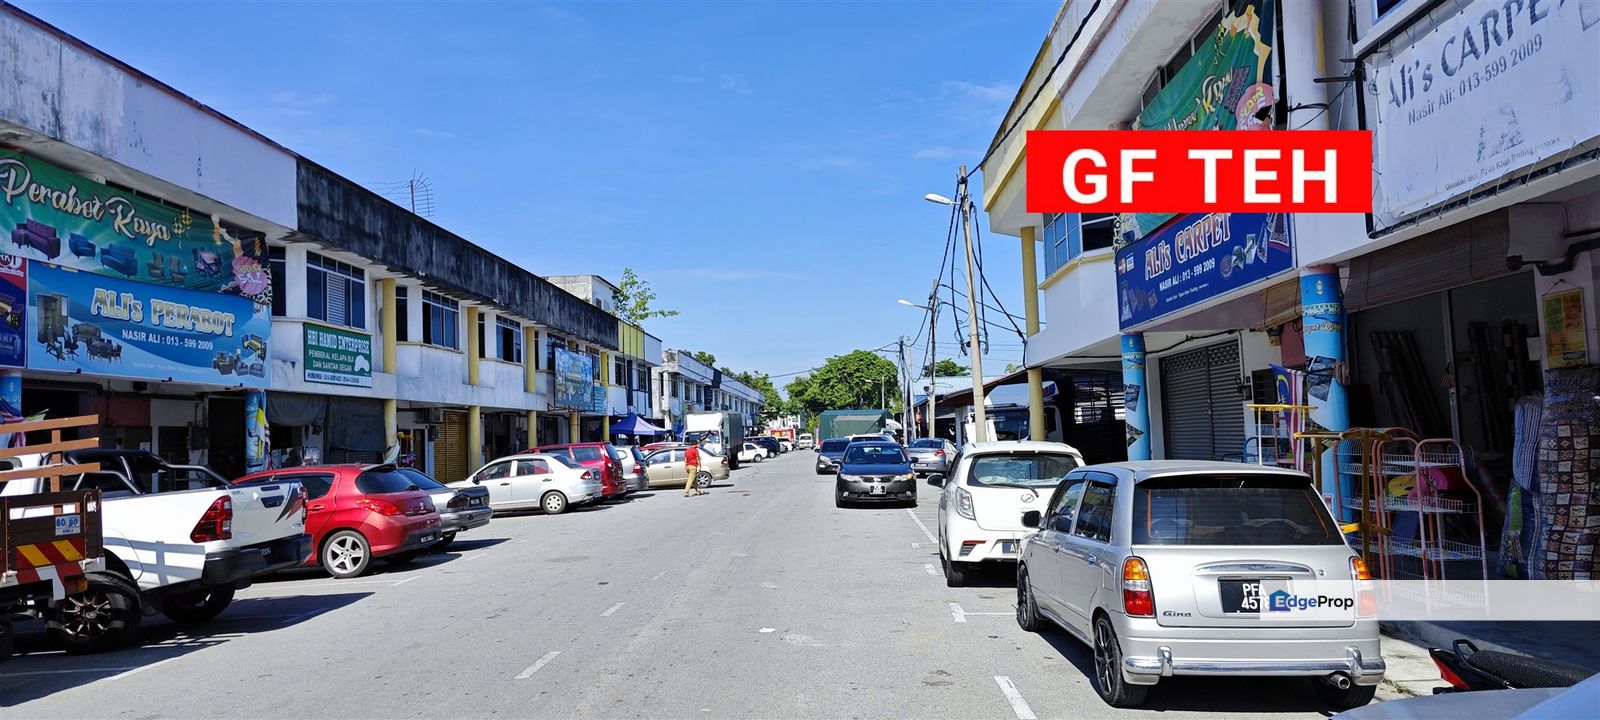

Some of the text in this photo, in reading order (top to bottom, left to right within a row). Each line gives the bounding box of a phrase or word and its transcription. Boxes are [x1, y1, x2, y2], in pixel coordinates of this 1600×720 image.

[1440, 0, 1567, 77] CARPE
[1407, 33, 1543, 126] Nasir Ali: 013-599 2009
[105, 196, 171, 247] Raya
[1144, 213, 1232, 281] ALI's CARPET
[1159, 278, 1172, 292] NASIR
[1172, 275, 1180, 287] ALI
[1182, 270, 1191, 282] 013
[90, 287, 236, 338] ALI's PERABOT
[122, 329, 147, 342] NASIR
[148, 332, 161, 344] ALI
[166, 335, 179, 347] 013
[184, 337, 198, 349] 599
[197, 338, 214, 352] 2009
[319, 332, 338, 349] HAMID
[338, 335, 370, 354] ENTERPRISE
[308, 349, 331, 361] PEMBEKAL
[331, 353, 347, 362] KELAPA
[312, 360, 322, 368] DAN
[339, 364, 352, 372] SEGAR
[56, 517, 66, 527] 80
[1242, 584, 1266, 597] PFA
